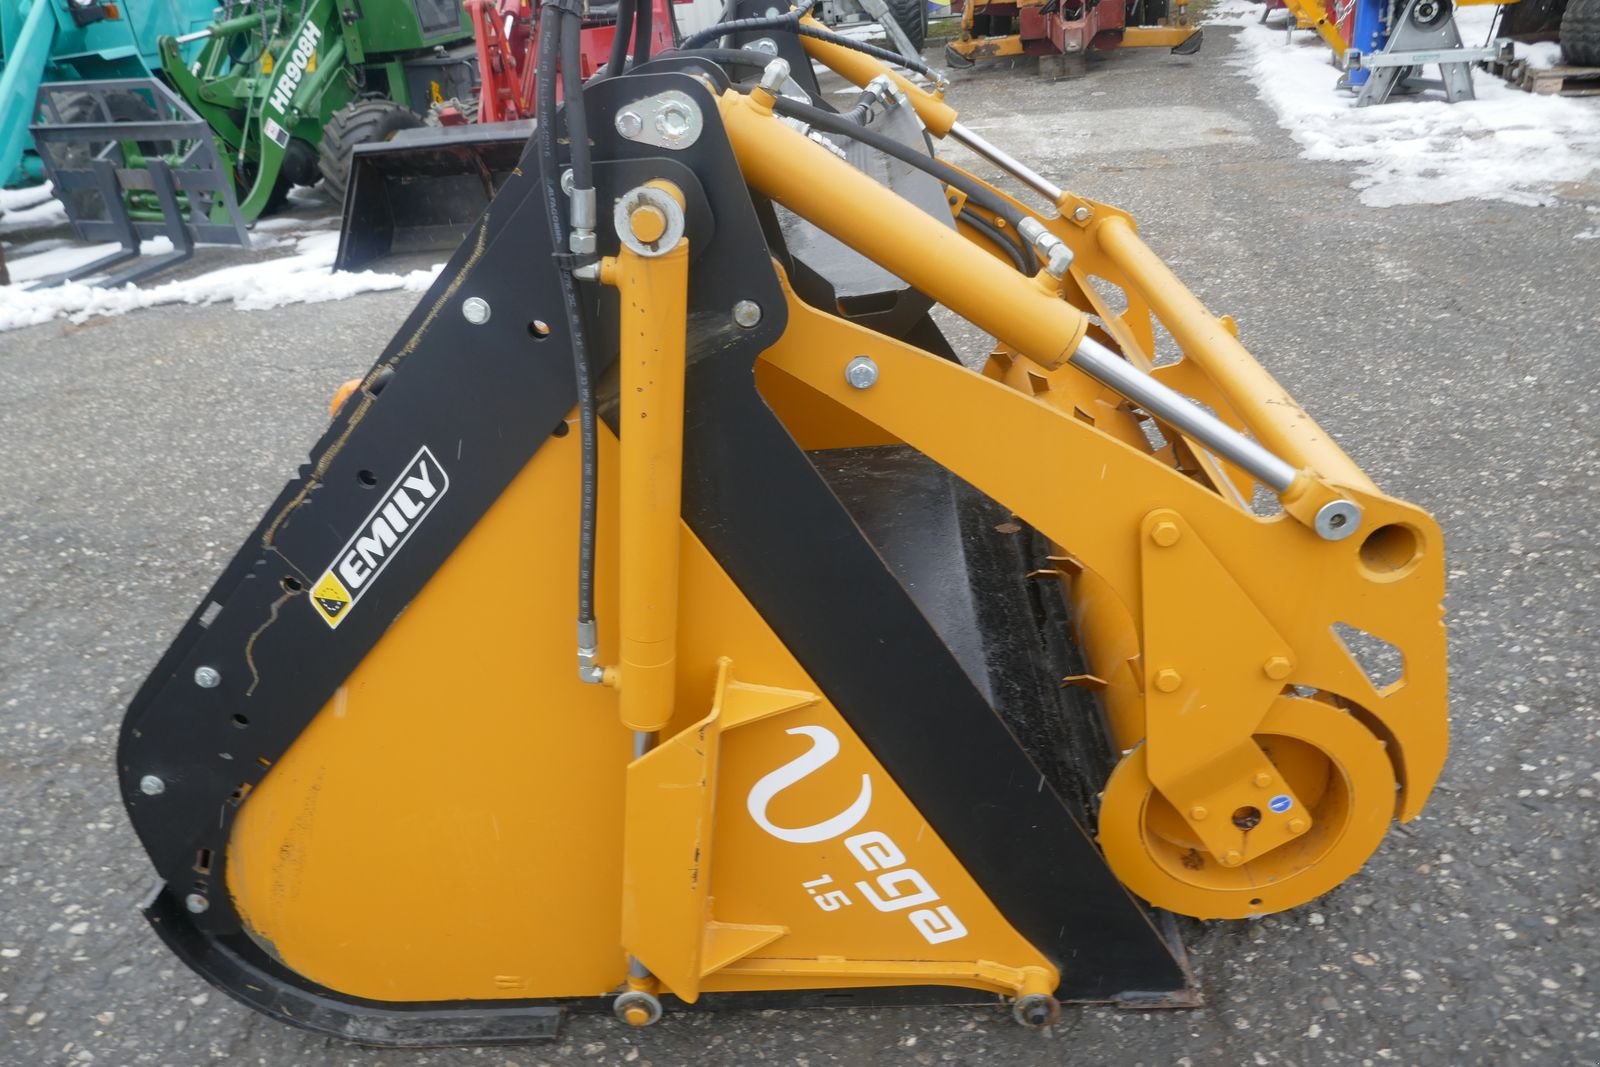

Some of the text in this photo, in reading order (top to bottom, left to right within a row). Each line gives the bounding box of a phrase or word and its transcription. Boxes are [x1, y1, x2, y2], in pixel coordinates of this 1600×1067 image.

[269, 20, 321, 115] HR908H
[339, 460, 437, 589] EMILY
[747, 725, 969, 944] Vega
[802, 874, 853, 912] 1.5
